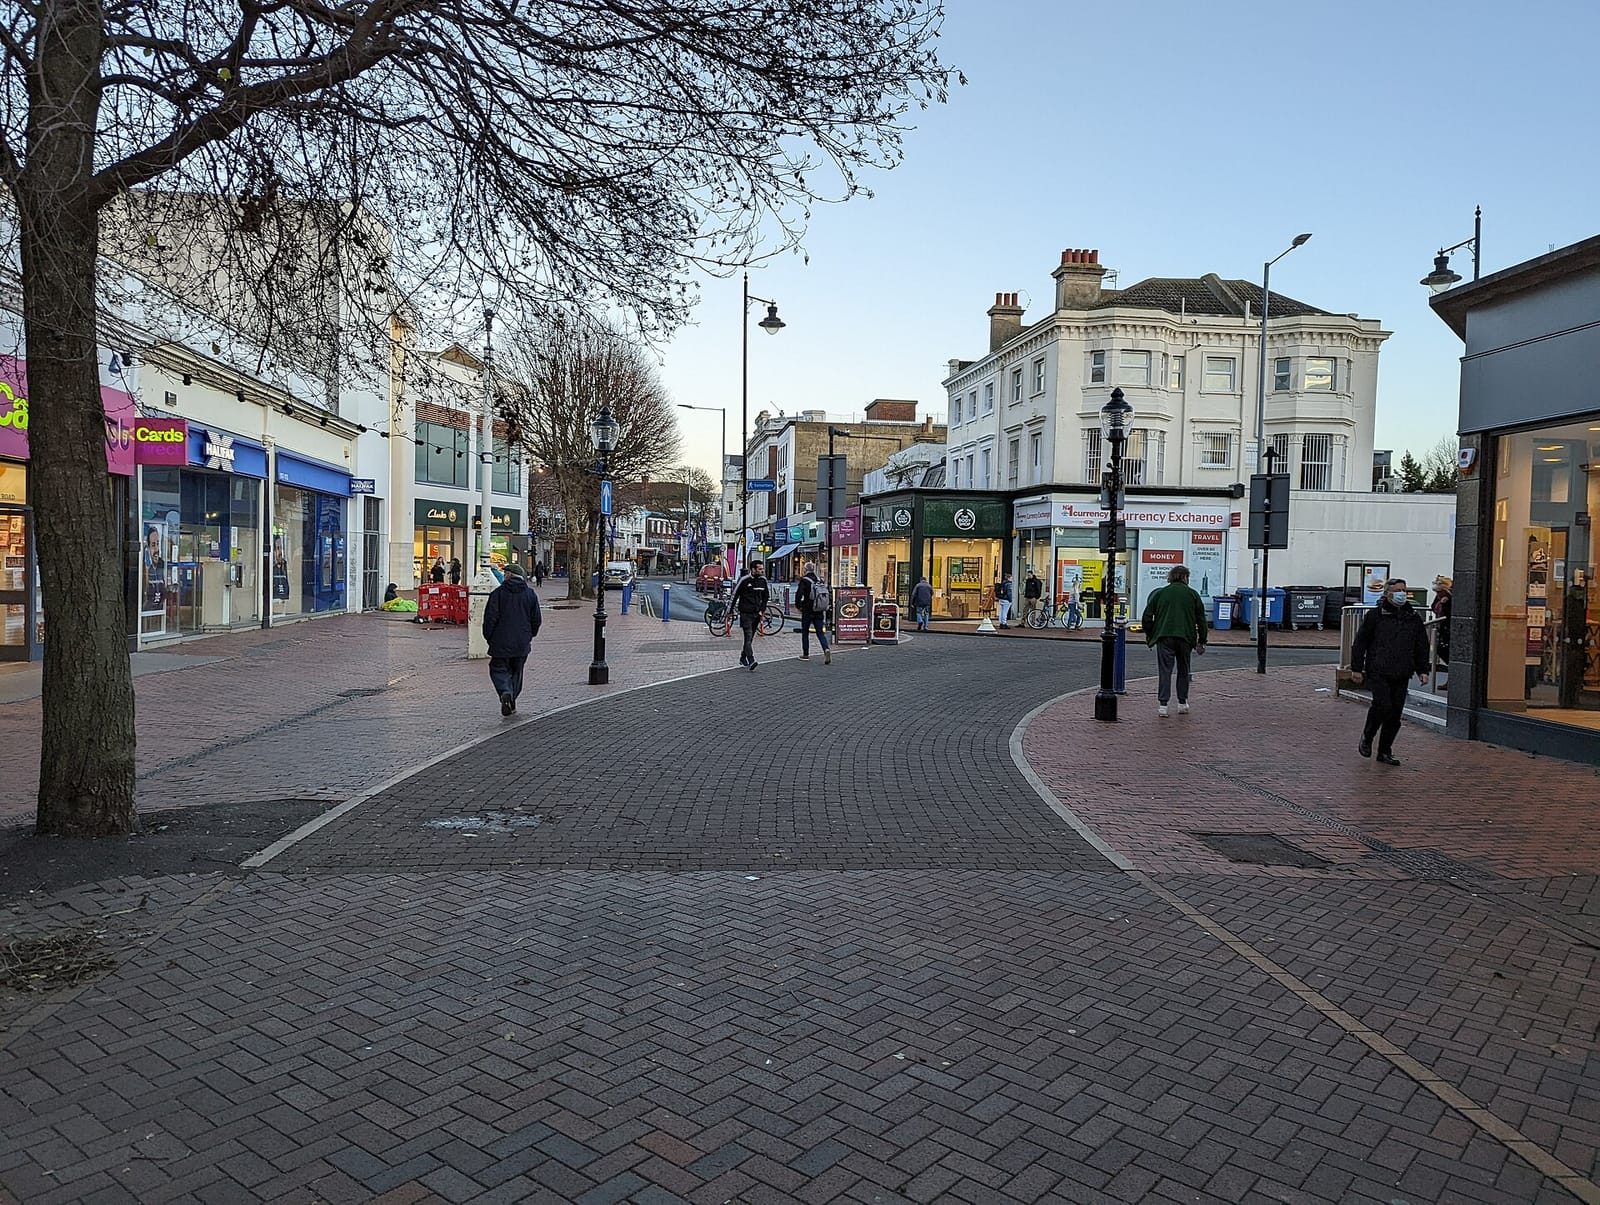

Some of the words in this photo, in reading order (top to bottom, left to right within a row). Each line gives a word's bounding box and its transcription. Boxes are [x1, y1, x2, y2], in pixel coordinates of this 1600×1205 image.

[136, 427, 184, 442] Cards
[139, 443, 181, 455] direct
[206, 442, 235, 461] HALIFAX
[1168, 512, 1223, 525] Exchange
[871, 522, 880, 532] THE
